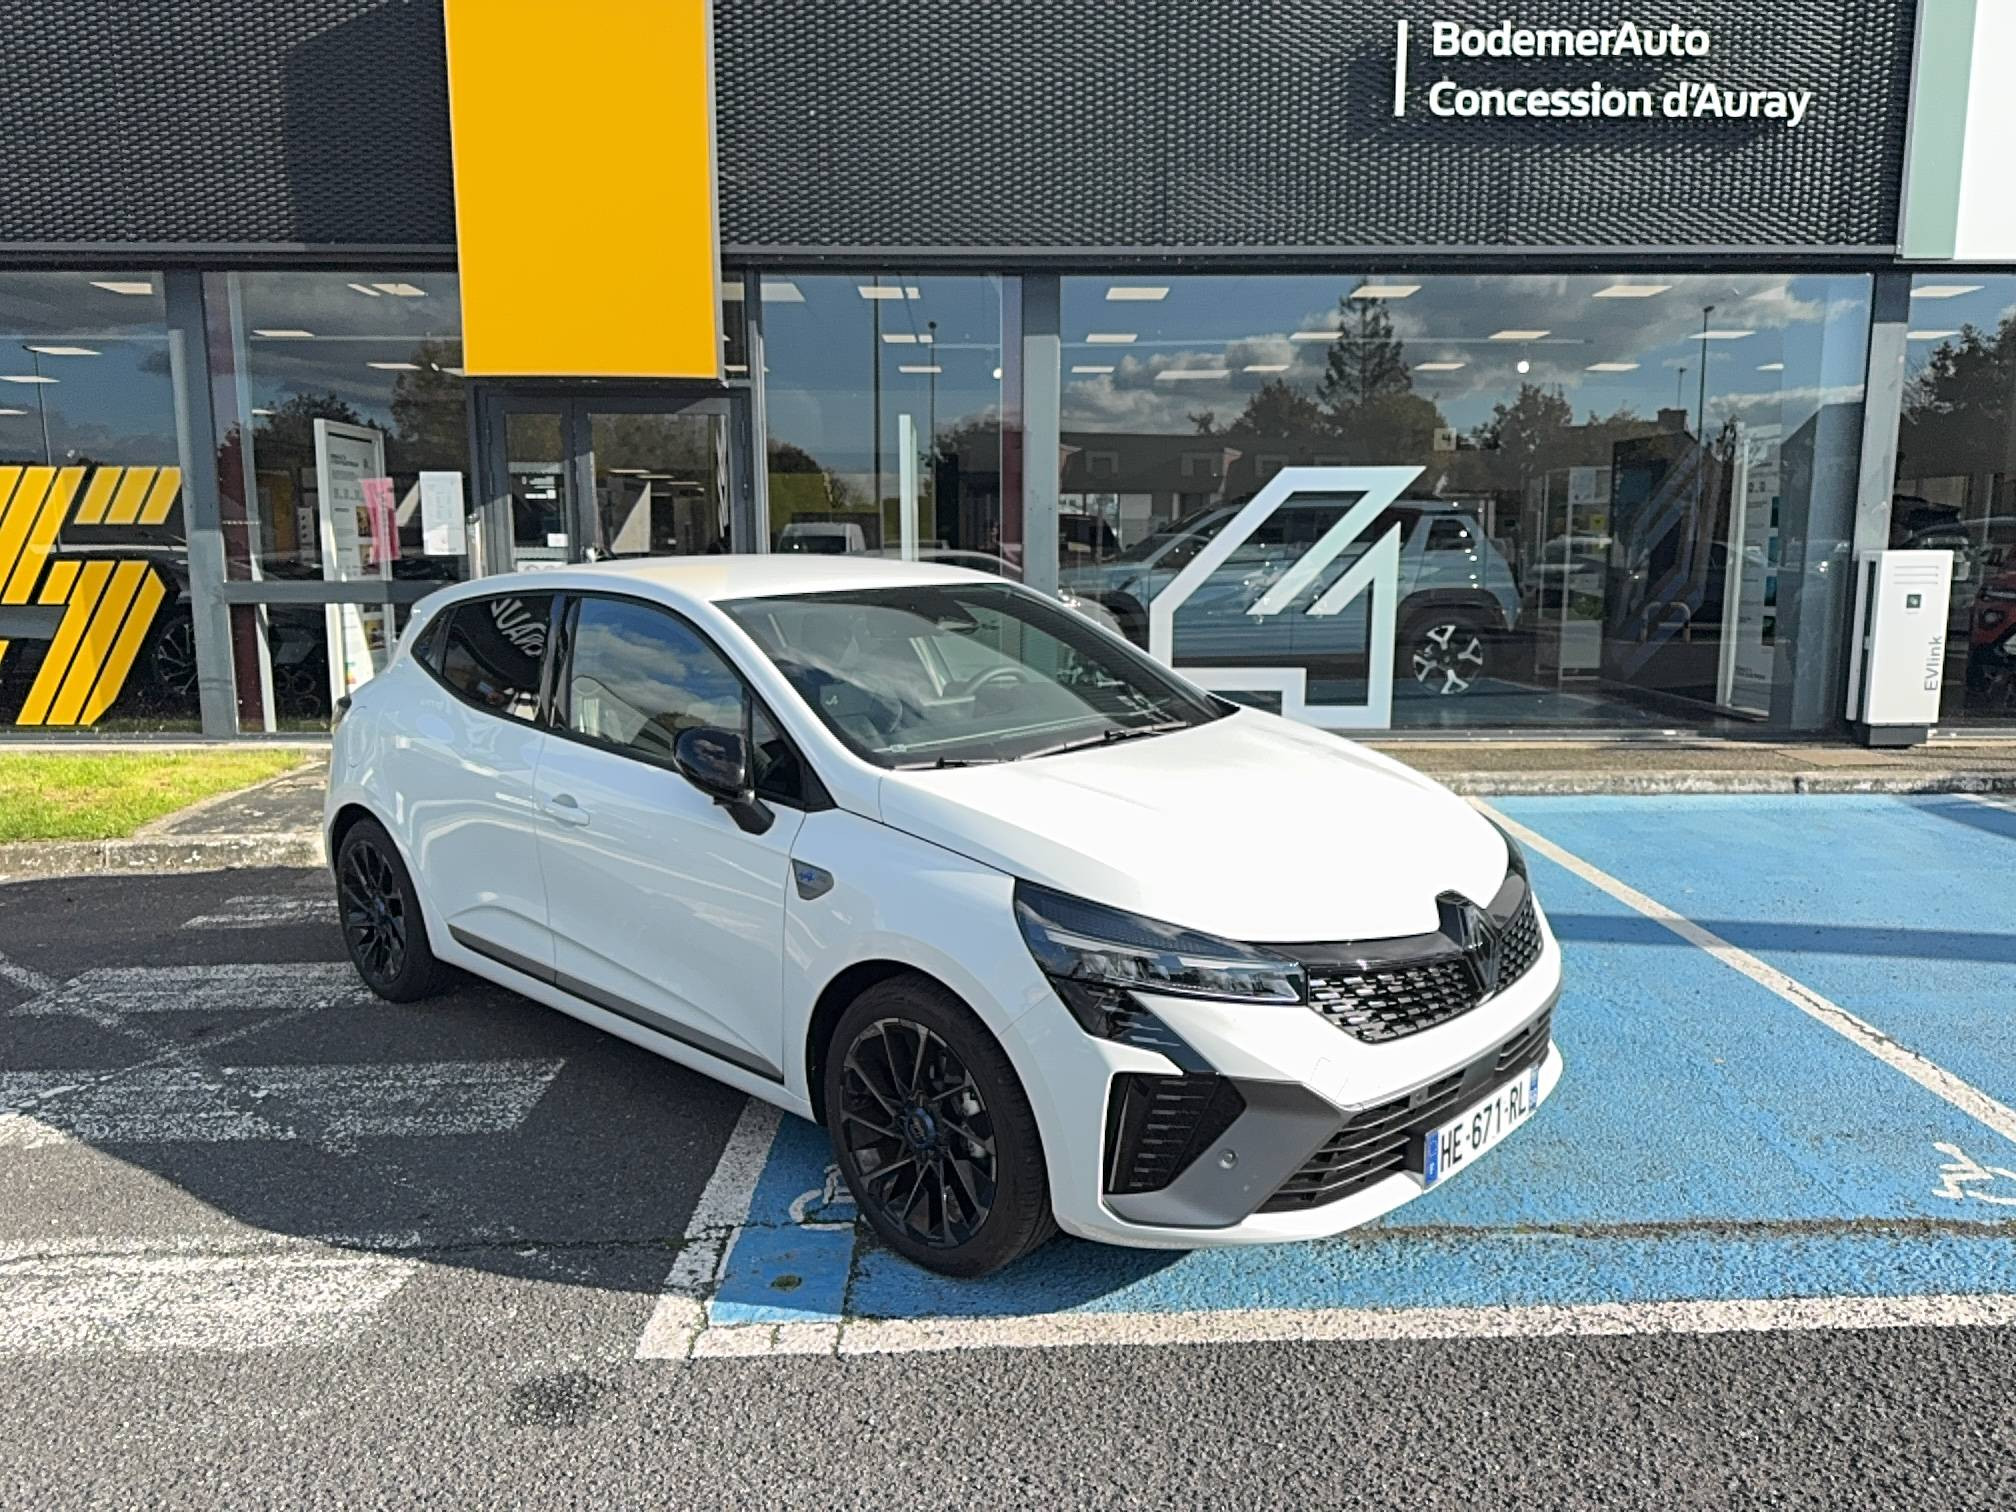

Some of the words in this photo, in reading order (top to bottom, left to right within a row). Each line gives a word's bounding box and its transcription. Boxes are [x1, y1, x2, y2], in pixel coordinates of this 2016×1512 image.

[1432, 20, 1710, 57] BodemerAuto
[1428, 81, 1652, 118] Concession
[1662, 82, 1812, 127] d'Auray
[1923, 635, 1943, 691] EVlink
[1440, 1080, 1527, 1173] HE-671-RL
